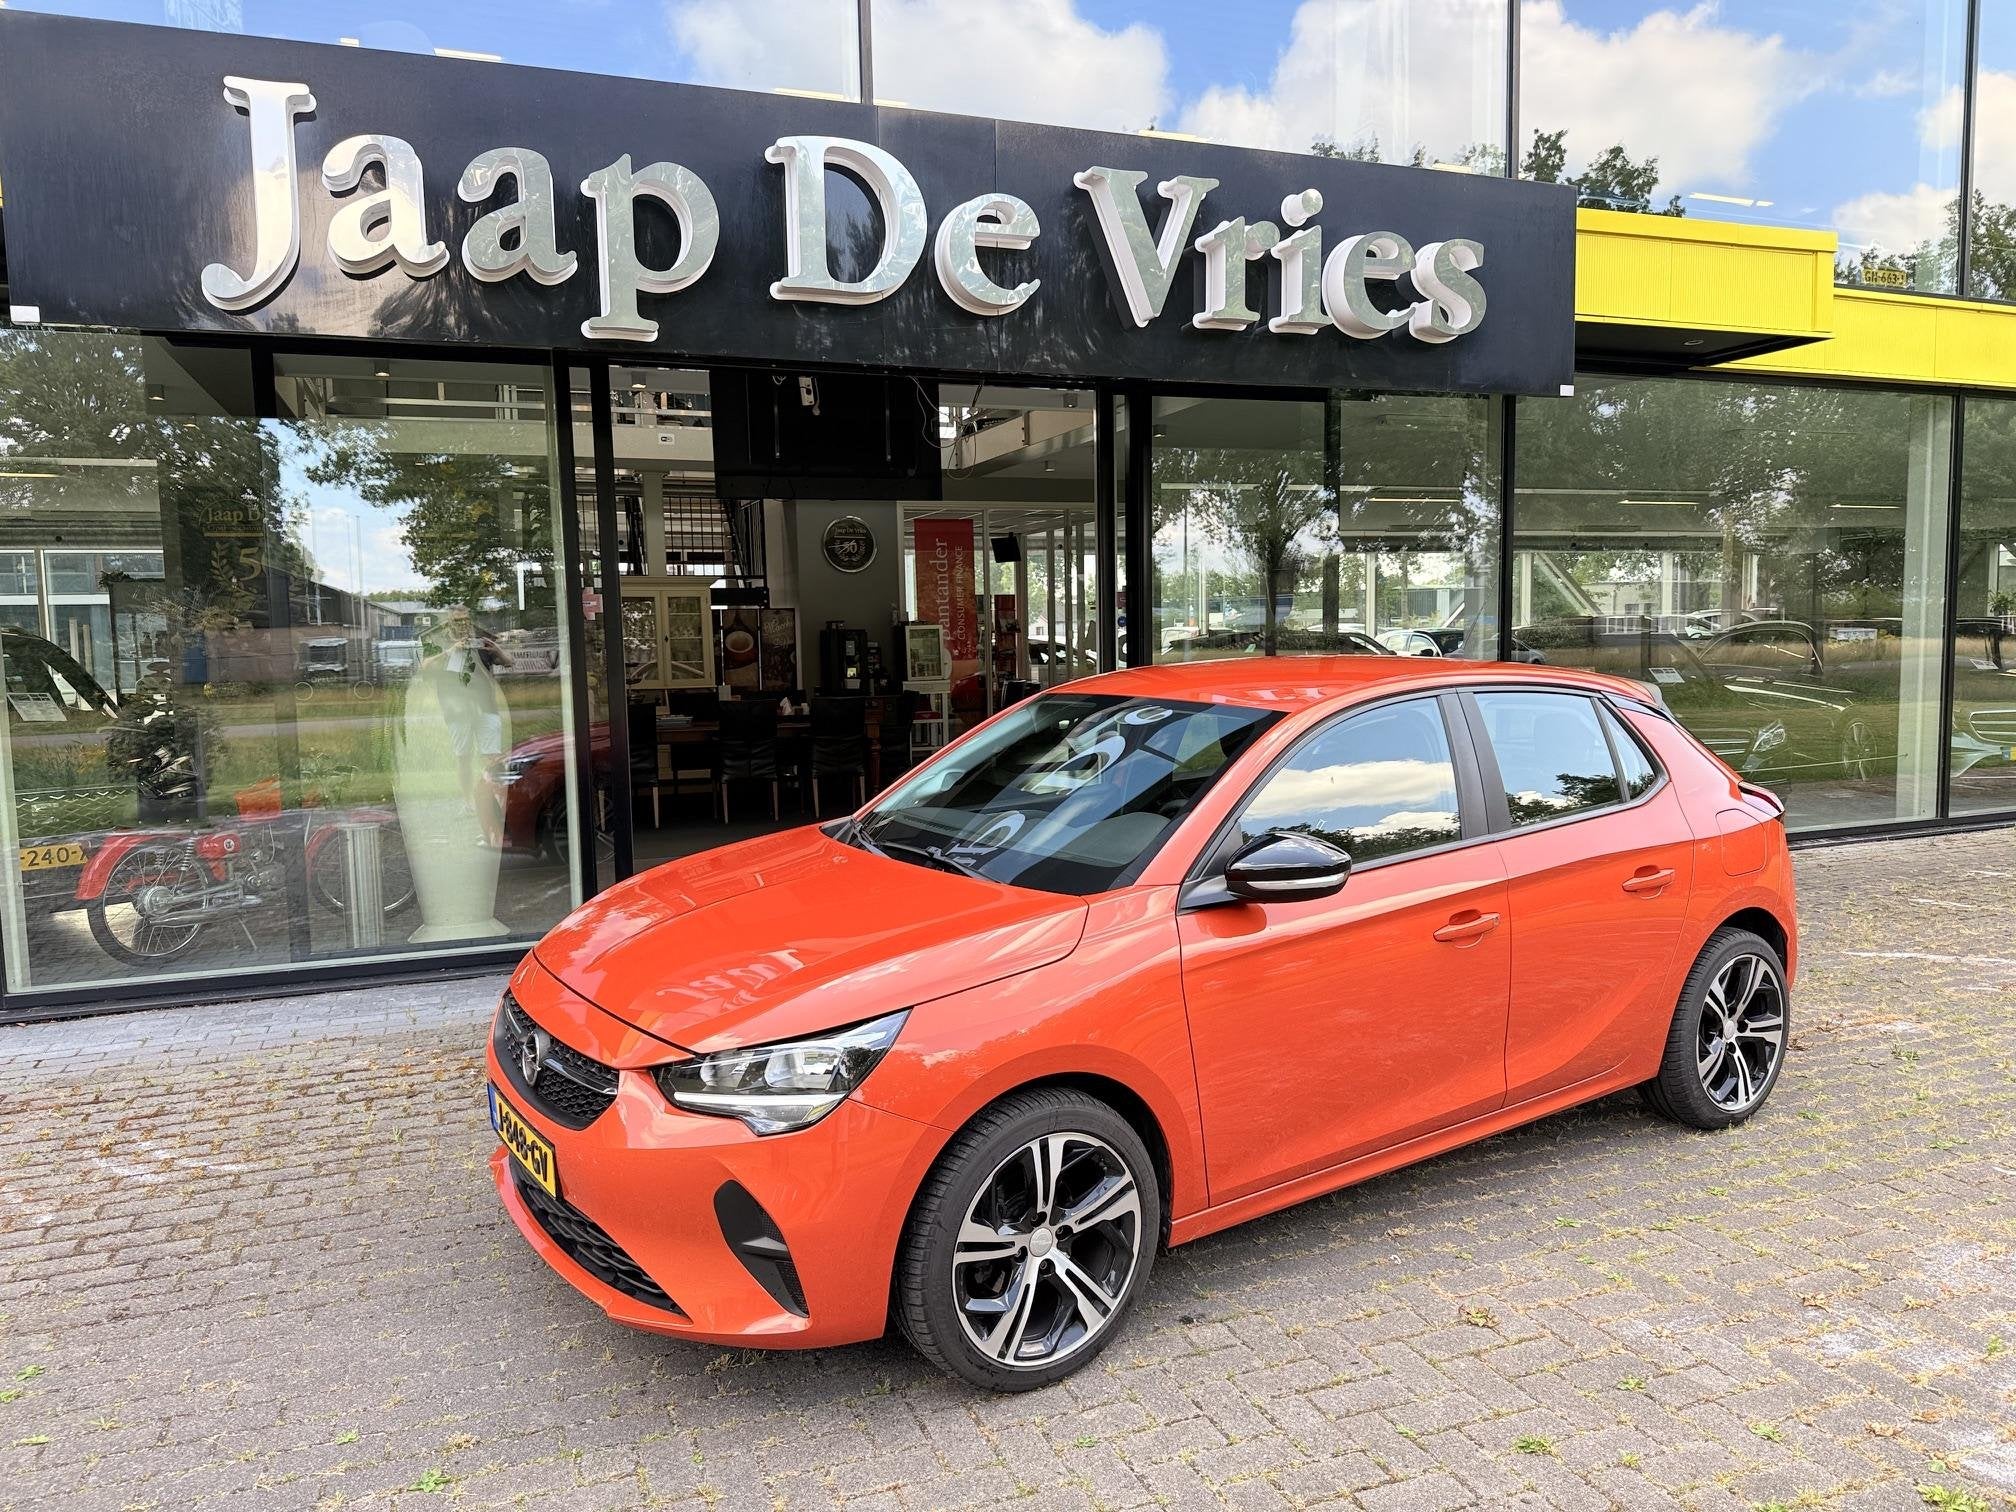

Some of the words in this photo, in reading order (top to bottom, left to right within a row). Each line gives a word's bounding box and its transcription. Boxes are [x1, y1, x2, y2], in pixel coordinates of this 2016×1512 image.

[201, 75, 721, 342] Jaap
[765, 134, 1042, 318] De
[1073, 165, 1487, 344] Vries
[206, 507, 244, 525] Jaap
[247, 508, 264, 522] D
[955, 545, 965, 584] FINANCE
[956, 586, 966, 640] CONSUMER
